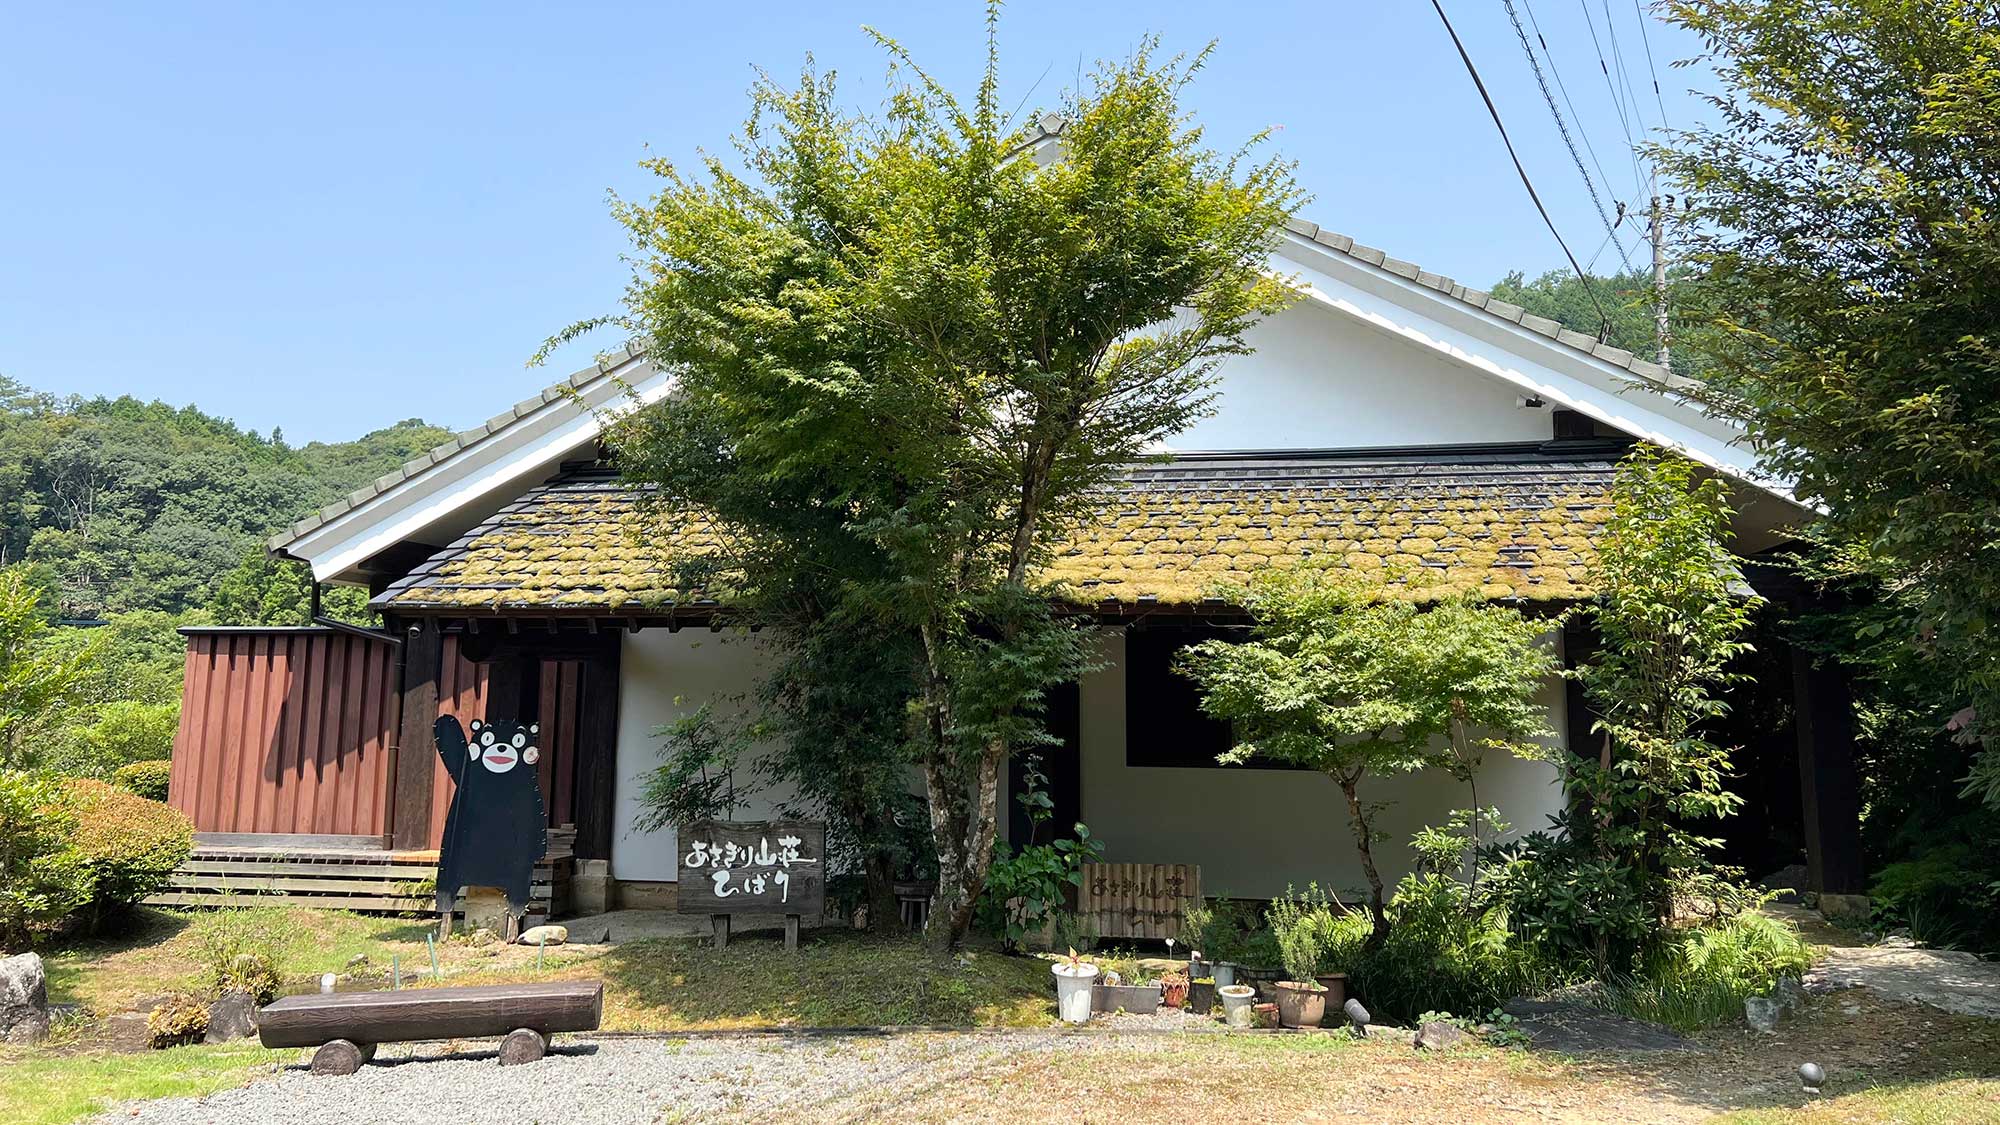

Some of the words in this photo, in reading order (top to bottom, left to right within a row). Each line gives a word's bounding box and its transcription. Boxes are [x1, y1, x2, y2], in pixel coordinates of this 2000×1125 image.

[685, 835, 817, 868] あさぎり山荘
[711, 870, 789, 903] ひばり
